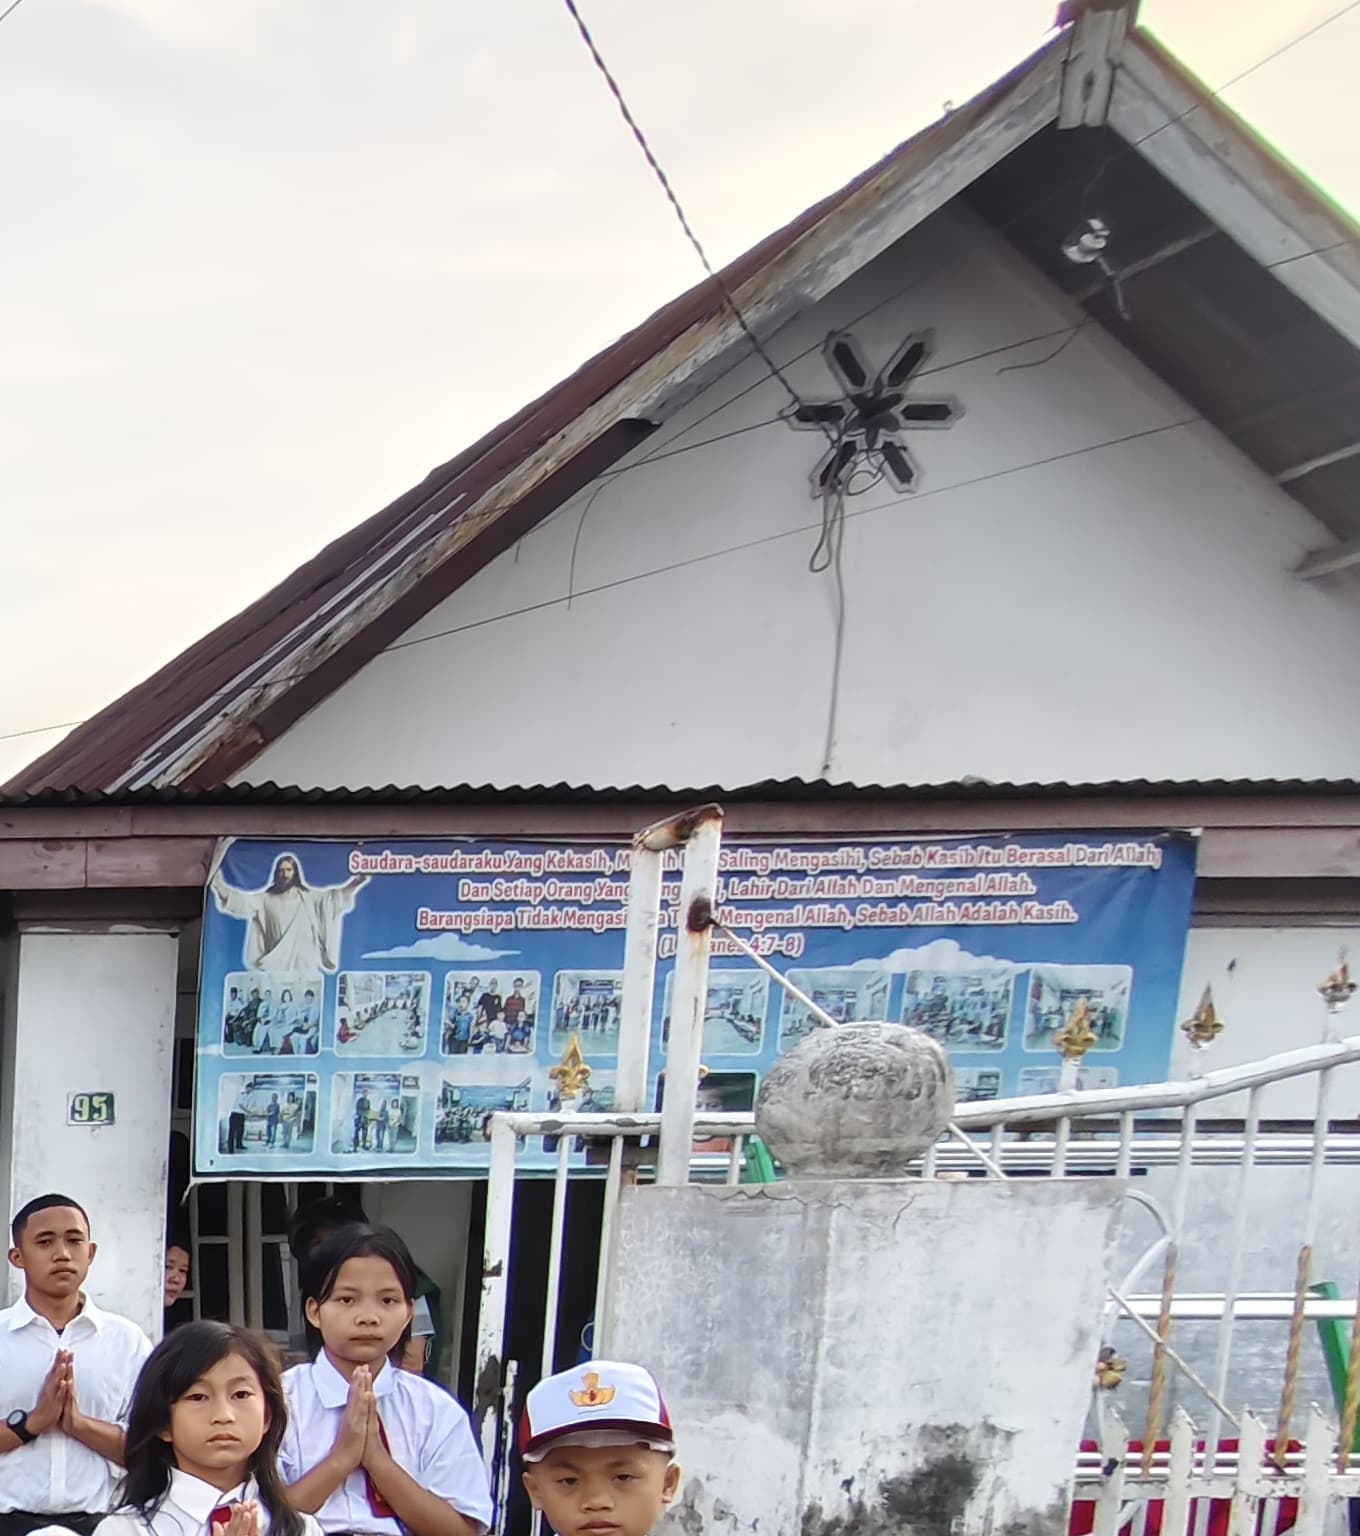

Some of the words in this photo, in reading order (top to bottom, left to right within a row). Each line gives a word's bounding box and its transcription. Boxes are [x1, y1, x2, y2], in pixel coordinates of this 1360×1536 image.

[350, 852, 503, 871] Saudara-saudaraku
[505, 852, 543, 873] Yang
[547, 849, 613, 871] Kekasih,
[719, 851, 769, 872] Saling
[774, 850, 867, 871] Mengasihi,
[870, 849, 922, 866] Sebab
[927, 848, 974, 865] Kasih
[978, 847, 1001, 864] Itu
[1006, 846, 1071, 864] Berasal
[1075, 846, 1111, 863] Dari
[460, 881, 490, 899] Dan
[494, 880, 542, 901] Setiap
[547, 881, 597, 901] Orang
[731, 880, 773, 896] Lahir
[776, 880, 812, 896] Dari
[815, 879, 857, 896] Allah
[863, 879, 895, 895] Dan
[899, 878, 982, 898] Mengenal
[985, 876, 1034, 893] Allah.
[419, 910, 514, 931] Barangsiapa
[518, 909, 559, 926] Tidak
[719, 908, 801, 928] Mengenal
[804, 907, 853, 927] Allah,
[858, 906, 910, 923] Sebab
[913, 904, 956, 922] Allah
[960, 903, 1019, 921] Adalah
[1023, 902, 1076, 920] Kasih.
[74, 1095, 107, 1121] 95
